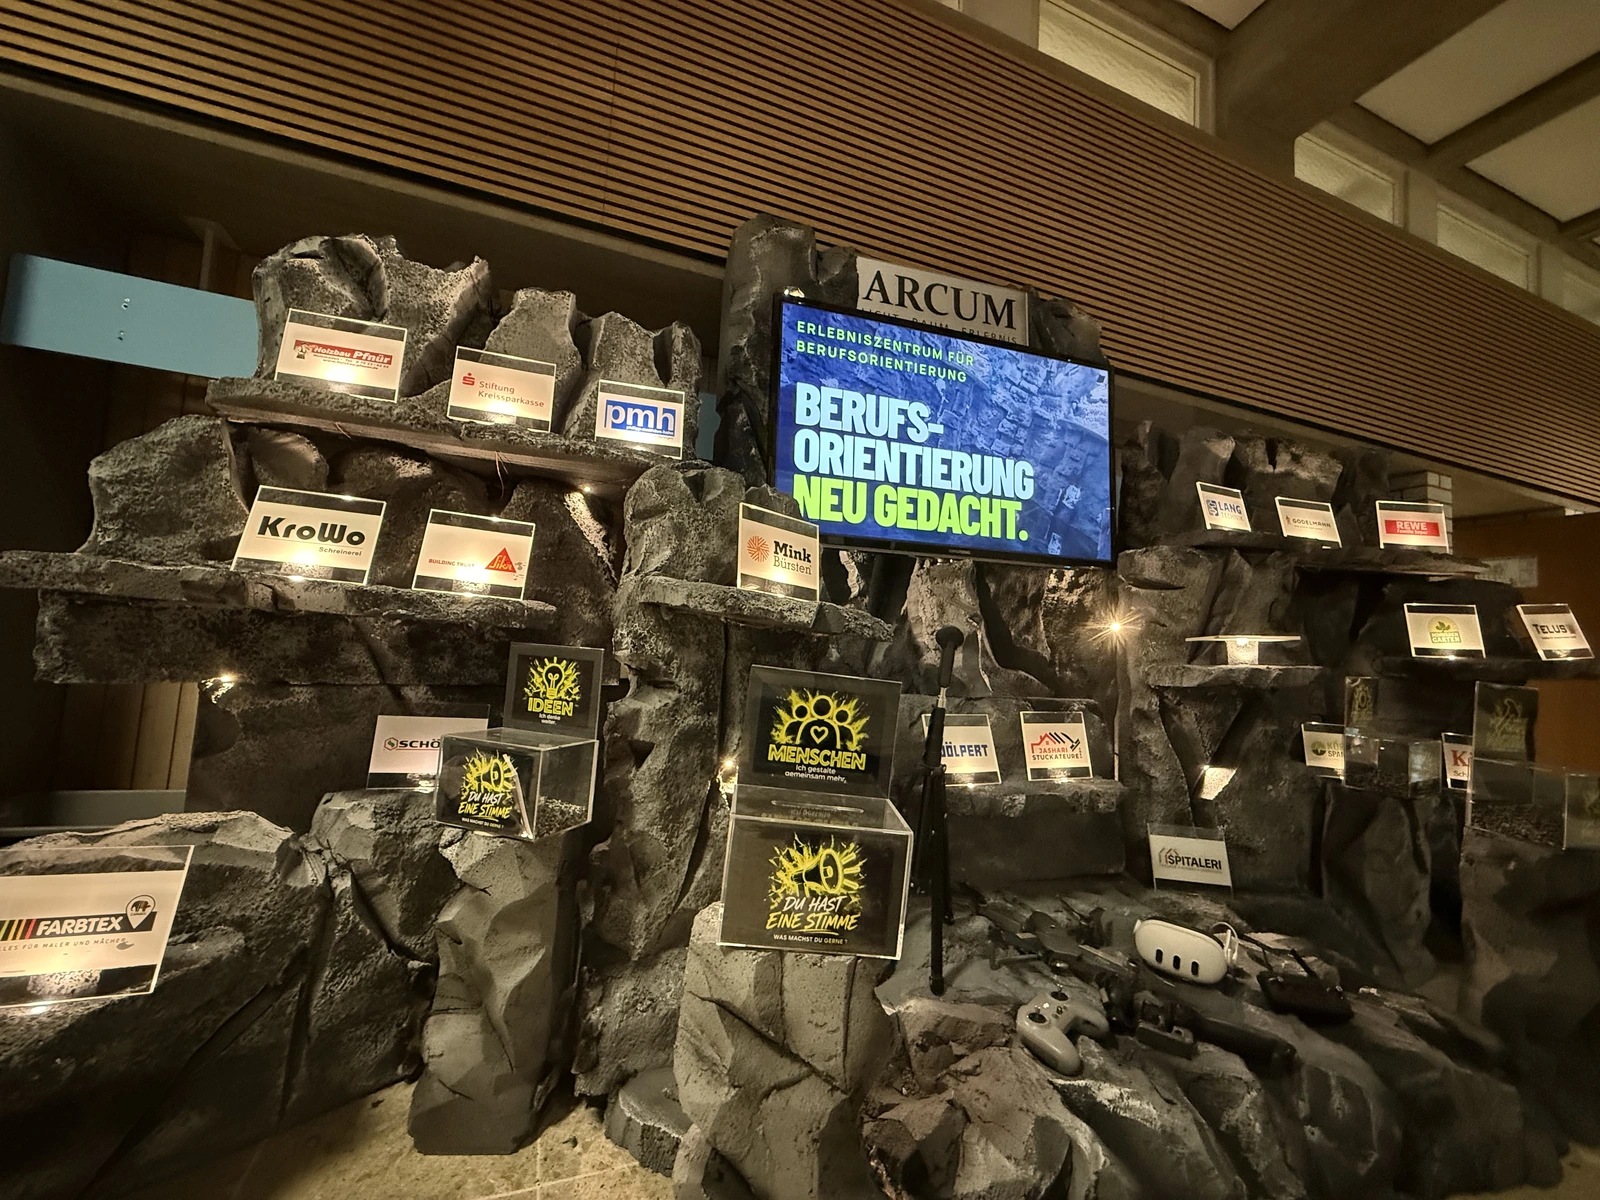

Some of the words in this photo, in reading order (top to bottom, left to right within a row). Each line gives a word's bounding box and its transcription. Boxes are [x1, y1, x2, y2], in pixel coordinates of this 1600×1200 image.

[862, 270, 1017, 330] ARCUM
[796, 320, 943, 361] ERLEBNISZENTRUM
[948, 350, 975, 367] FÜR
[313, 346, 351, 358] Holzbau
[353, 350, 391, 364] Pfnür
[796, 340, 968, 383] BERUFSORIENTIERUNG
[479, 380, 515, 395] Stiftung
[478, 390, 545, 408] Kreissparkasse
[605, 404, 675, 431] pmh
[795, 382, 945, 444] BERUFS-
[793, 428, 1035, 500] ORIENTIERUNG
[792, 474, 867, 524] NEU
[873, 484, 1029, 542] GEDACHT.
[1218, 501, 1242, 514] LANG
[257, 515, 366, 546] KroWo
[1292, 518, 1332, 528] GODELMANN
[1396, 521, 1428, 531] REWE
[319, 547, 362, 557] Schreinerei
[773, 540, 812, 563] Mink
[428, 558, 455, 567] BUILDING
[773, 555, 812, 575] Bürsten
[527, 697, 574, 717] IDEEN
[767, 743, 867, 771] MENSCHEN
[795, 764, 807, 772] Ich
[807, 766, 836, 775] gestalte
[468, 790, 482, 802] DU
[482, 791, 506, 805] HAST
[458, 801, 480, 814] EINE
[479, 803, 512, 819] STIMME
[1167, 853, 1222, 870] SPITALERI
[781, 896, 807, 912] DU
[808, 895, 848, 913] HAST
[35, 915, 124, 936] FARBTEX
[765, 911, 805, 930] EINE
[803, 912, 861, 931] STIMME
[42, 941, 70, 949] MALER
[773, 933, 787, 941] WAS
[788, 934, 813, 943] MACHST
[823, 937, 844, 945] GERNE
